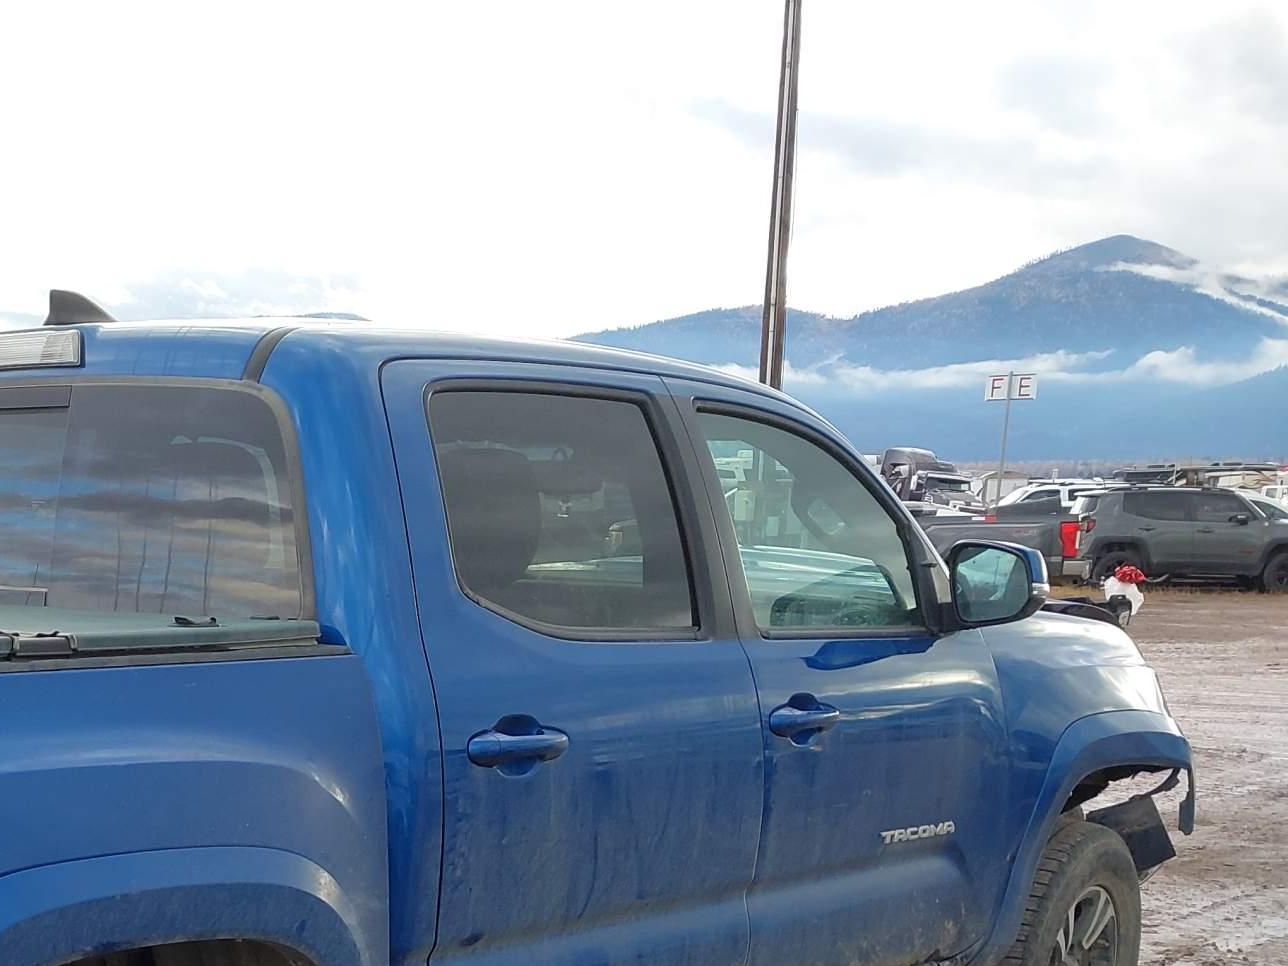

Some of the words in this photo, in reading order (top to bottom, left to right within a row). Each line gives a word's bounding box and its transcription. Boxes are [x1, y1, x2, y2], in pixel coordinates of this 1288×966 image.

[991, 377, 1004, 398] F
[1018, 376, 1032, 397] E
[880, 821, 955, 844] TACOMA
